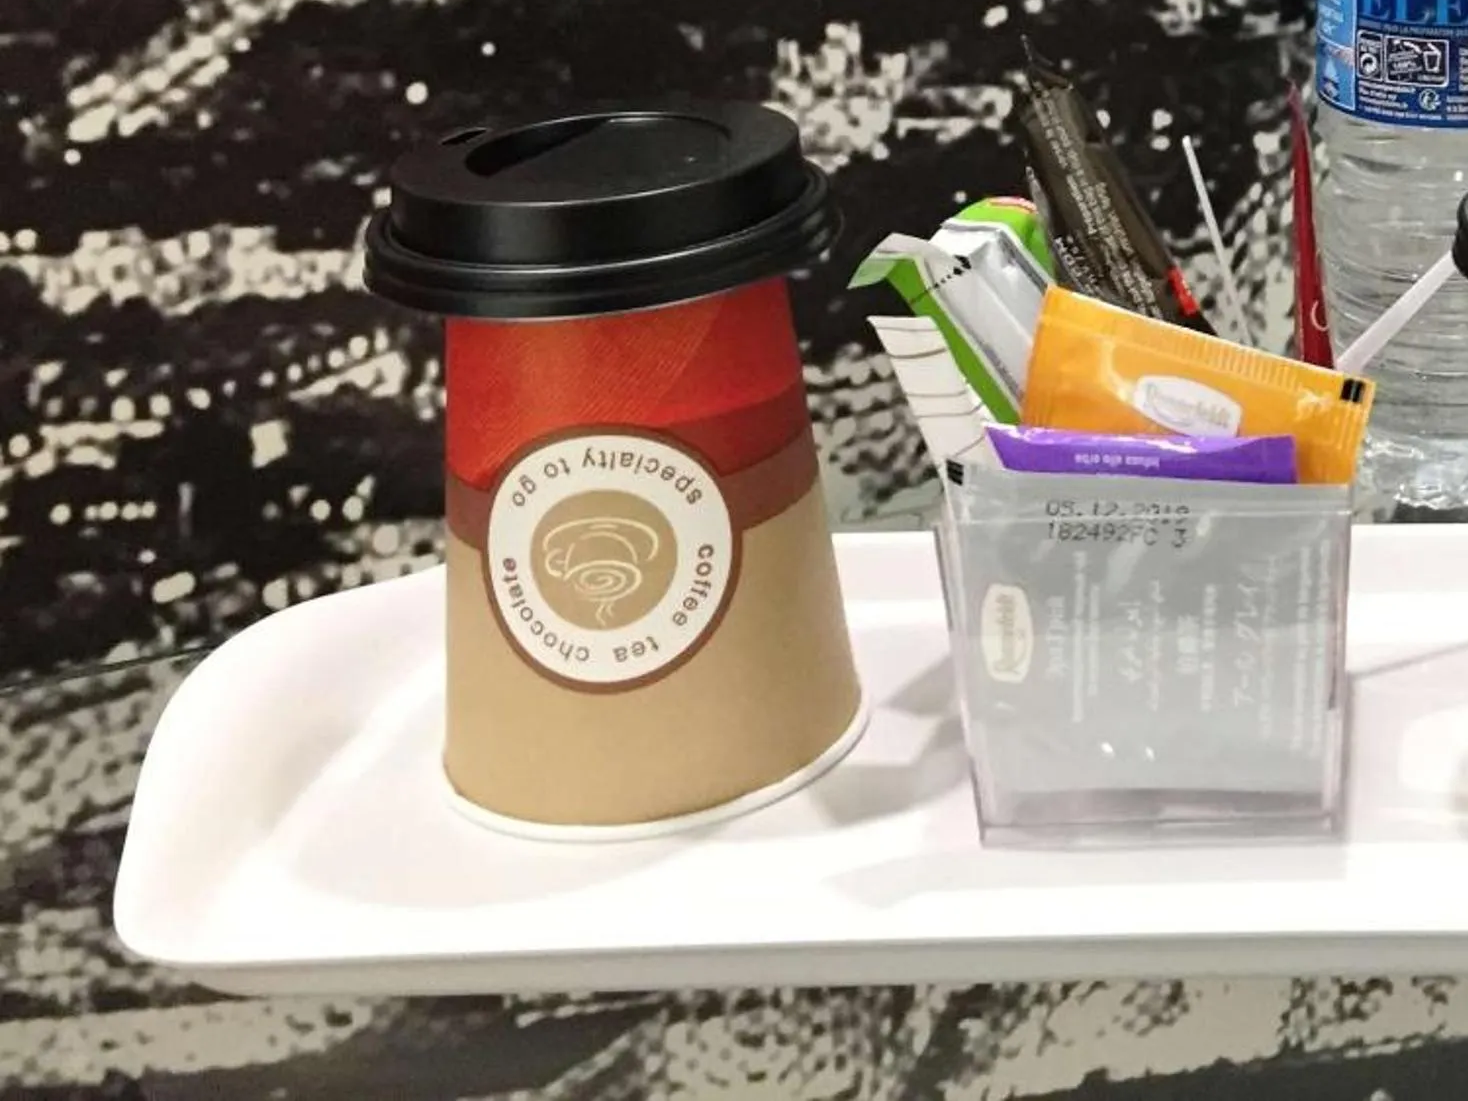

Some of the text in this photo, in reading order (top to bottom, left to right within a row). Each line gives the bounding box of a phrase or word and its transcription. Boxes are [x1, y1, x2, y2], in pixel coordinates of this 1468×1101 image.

[512, 447, 703, 507] specialty to go
[502, 544, 715, 663] coffee tea chocolate
